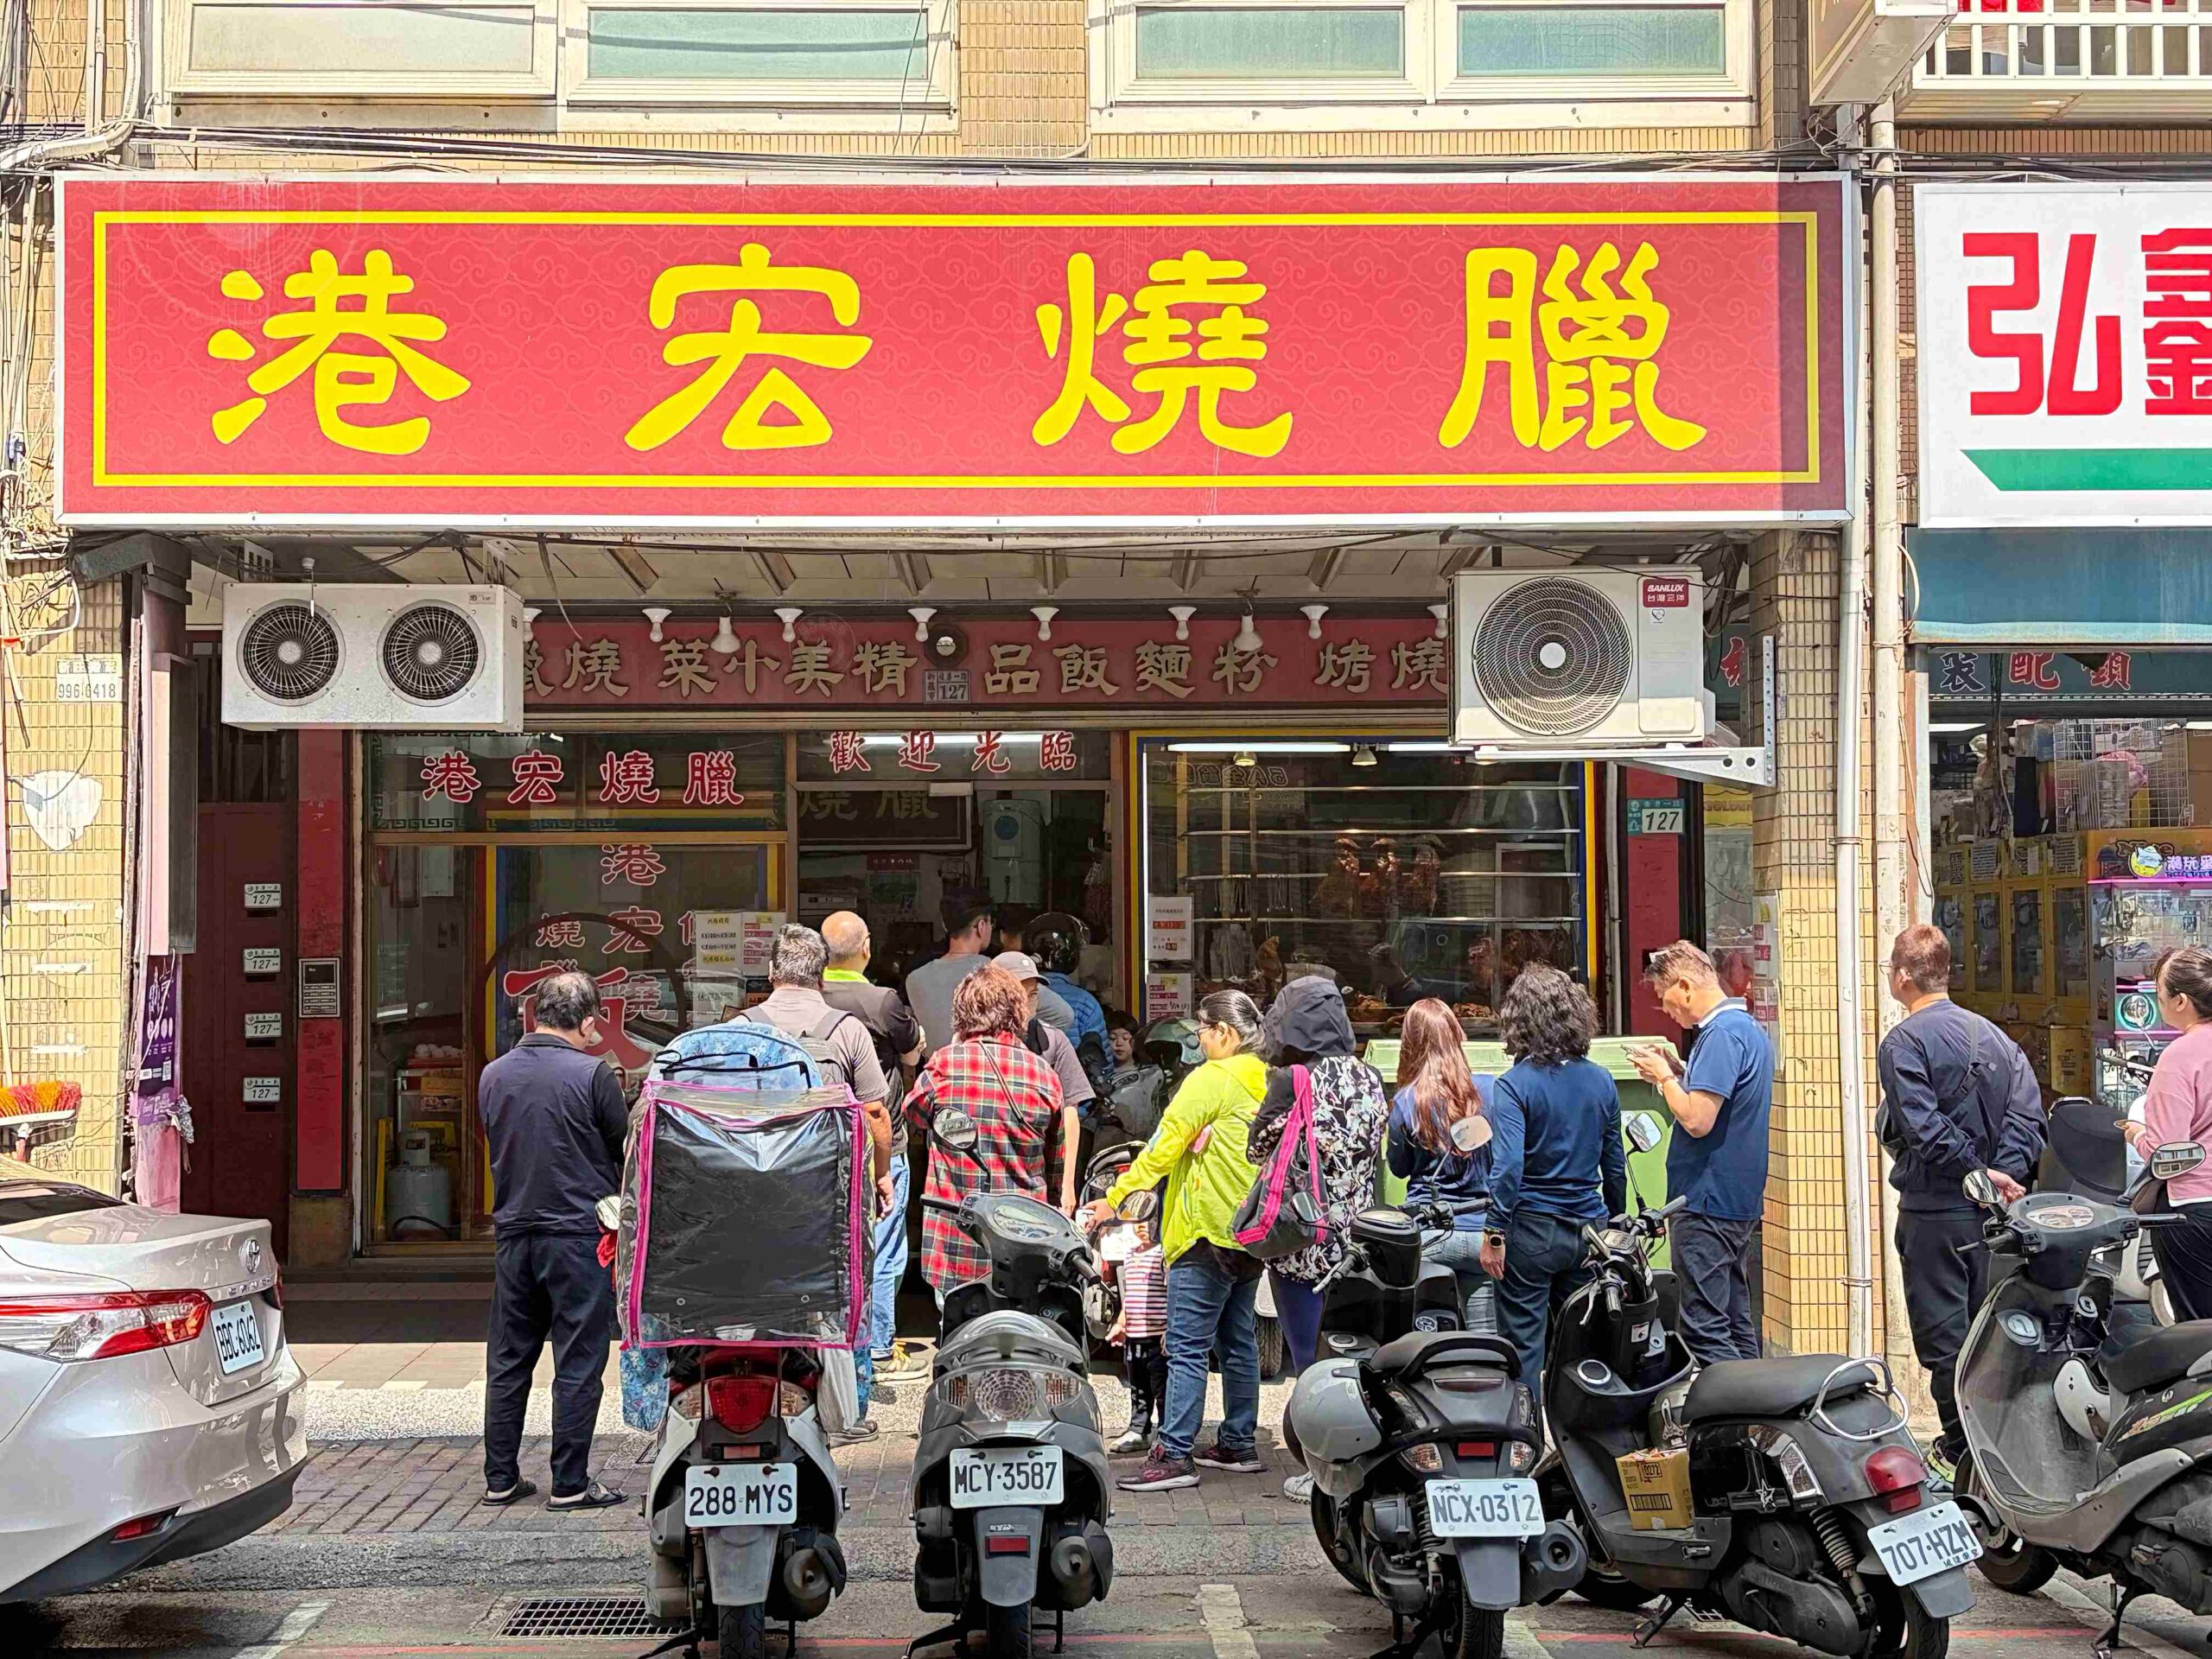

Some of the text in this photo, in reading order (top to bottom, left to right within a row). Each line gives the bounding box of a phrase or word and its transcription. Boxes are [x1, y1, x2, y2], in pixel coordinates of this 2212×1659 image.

[207, 240, 1707, 457] 港宏燒臘
[939, 683, 967, 700] 127
[829, 730, 1077, 773] 歡迎光臨
[420, 749, 745, 804] 港宏燒臘
[1645, 810, 1680, 831] 127
[252, 893, 272, 905] 127
[252, 959, 271, 969] 127
[253, 1024, 272, 1035] 127
[251, 1089, 270, 1099] 127
